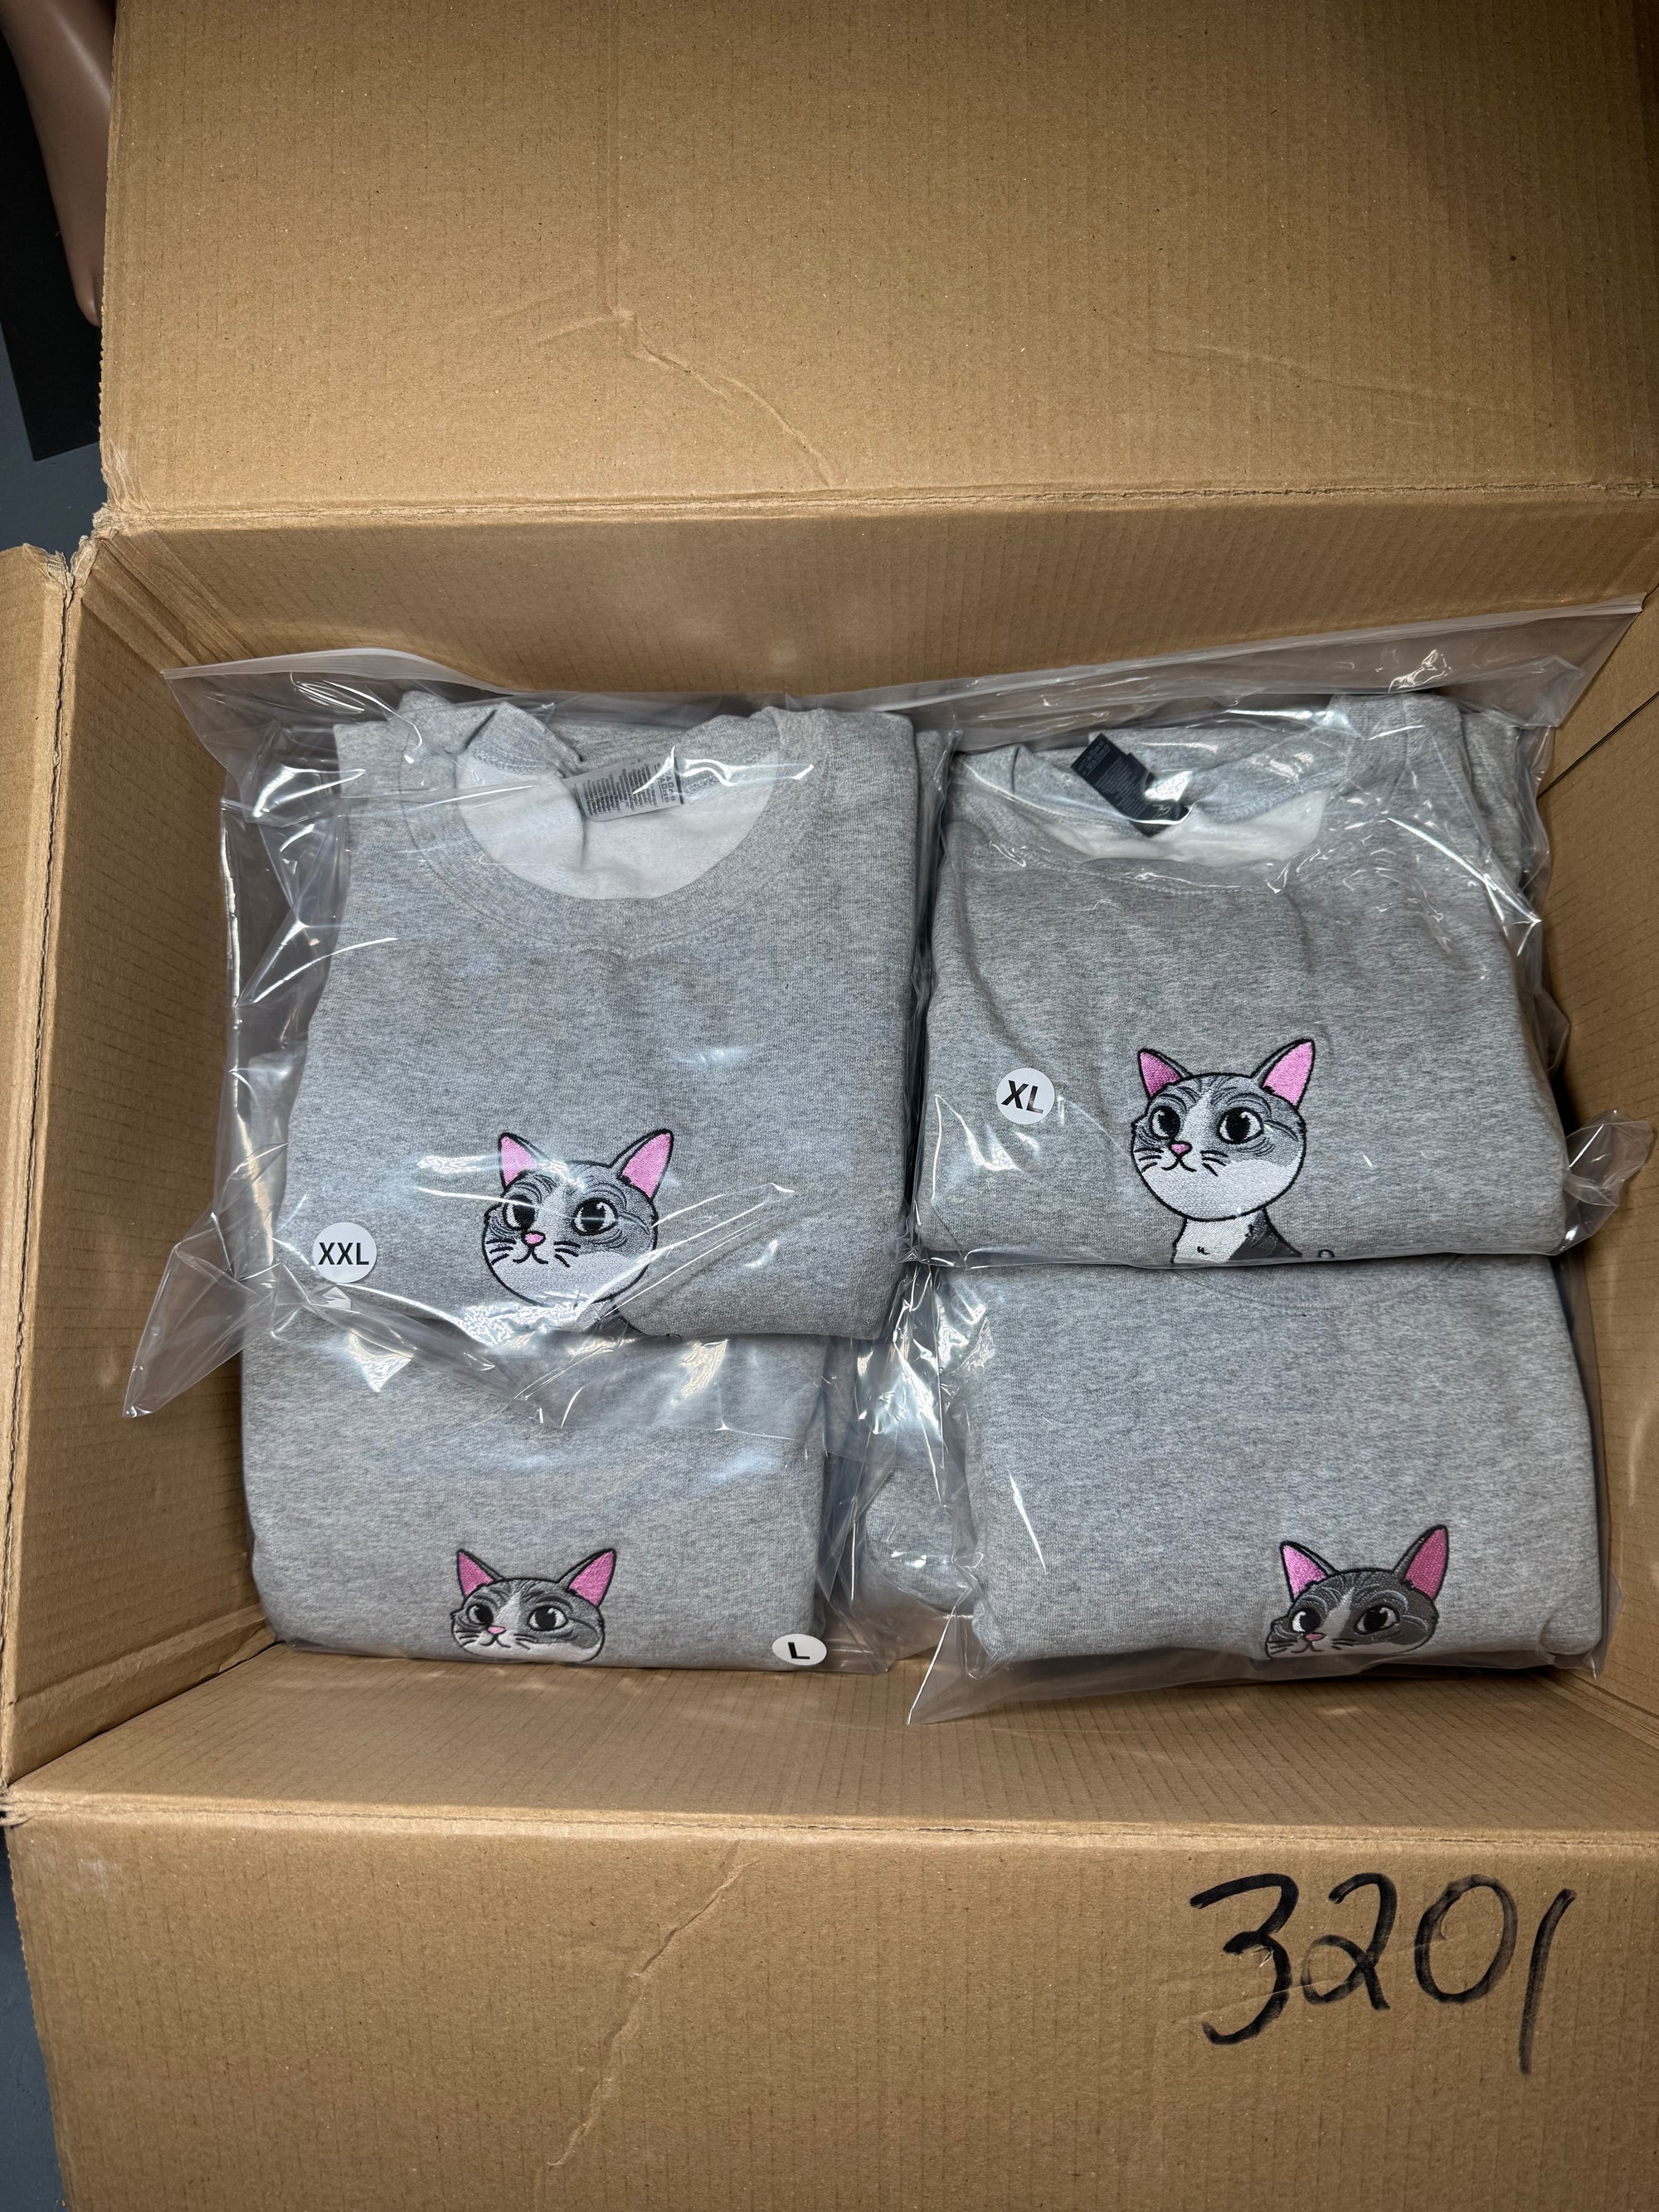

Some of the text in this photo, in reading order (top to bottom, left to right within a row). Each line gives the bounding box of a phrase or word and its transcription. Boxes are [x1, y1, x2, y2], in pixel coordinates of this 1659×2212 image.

[1001, 1080, 1044, 1114] XL
[319, 1242, 369, 1265] XXL
[788, 1642, 810, 1659] L
[1190, 1873, 1575, 2074] 3201
